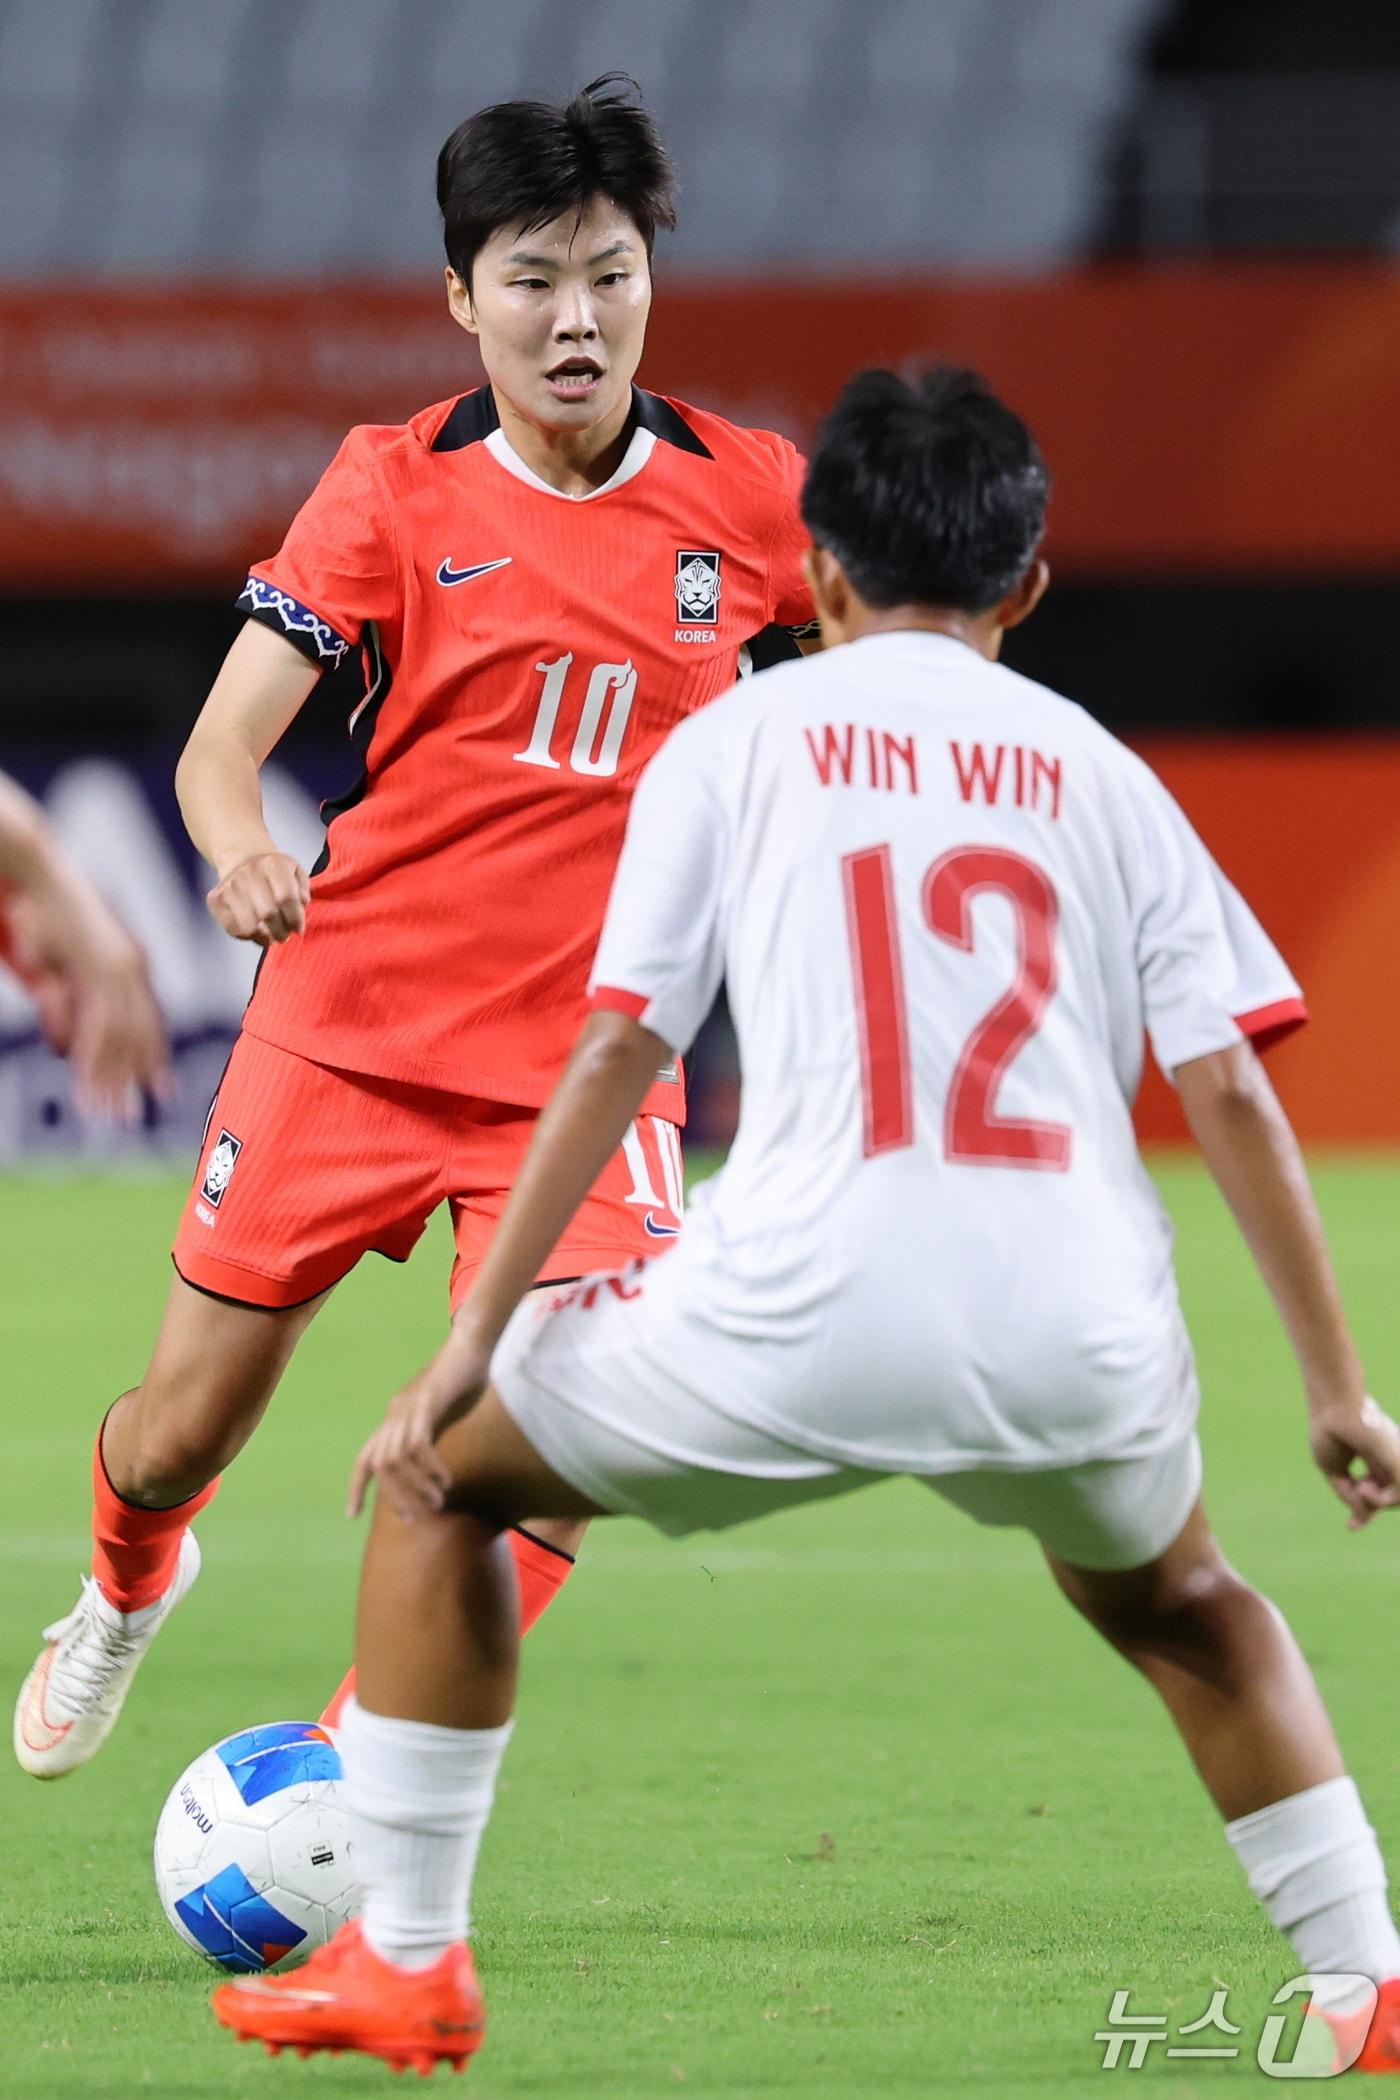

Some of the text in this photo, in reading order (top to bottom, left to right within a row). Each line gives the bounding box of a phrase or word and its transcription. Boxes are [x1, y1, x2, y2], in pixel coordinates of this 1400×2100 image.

[674, 629, 717, 643] KOREA
[512, 650, 638, 777] 10
[804, 723, 1062, 821] WIN WIN
[840, 842, 1073, 1174] 12
[180, 1782, 214, 1834] molten
